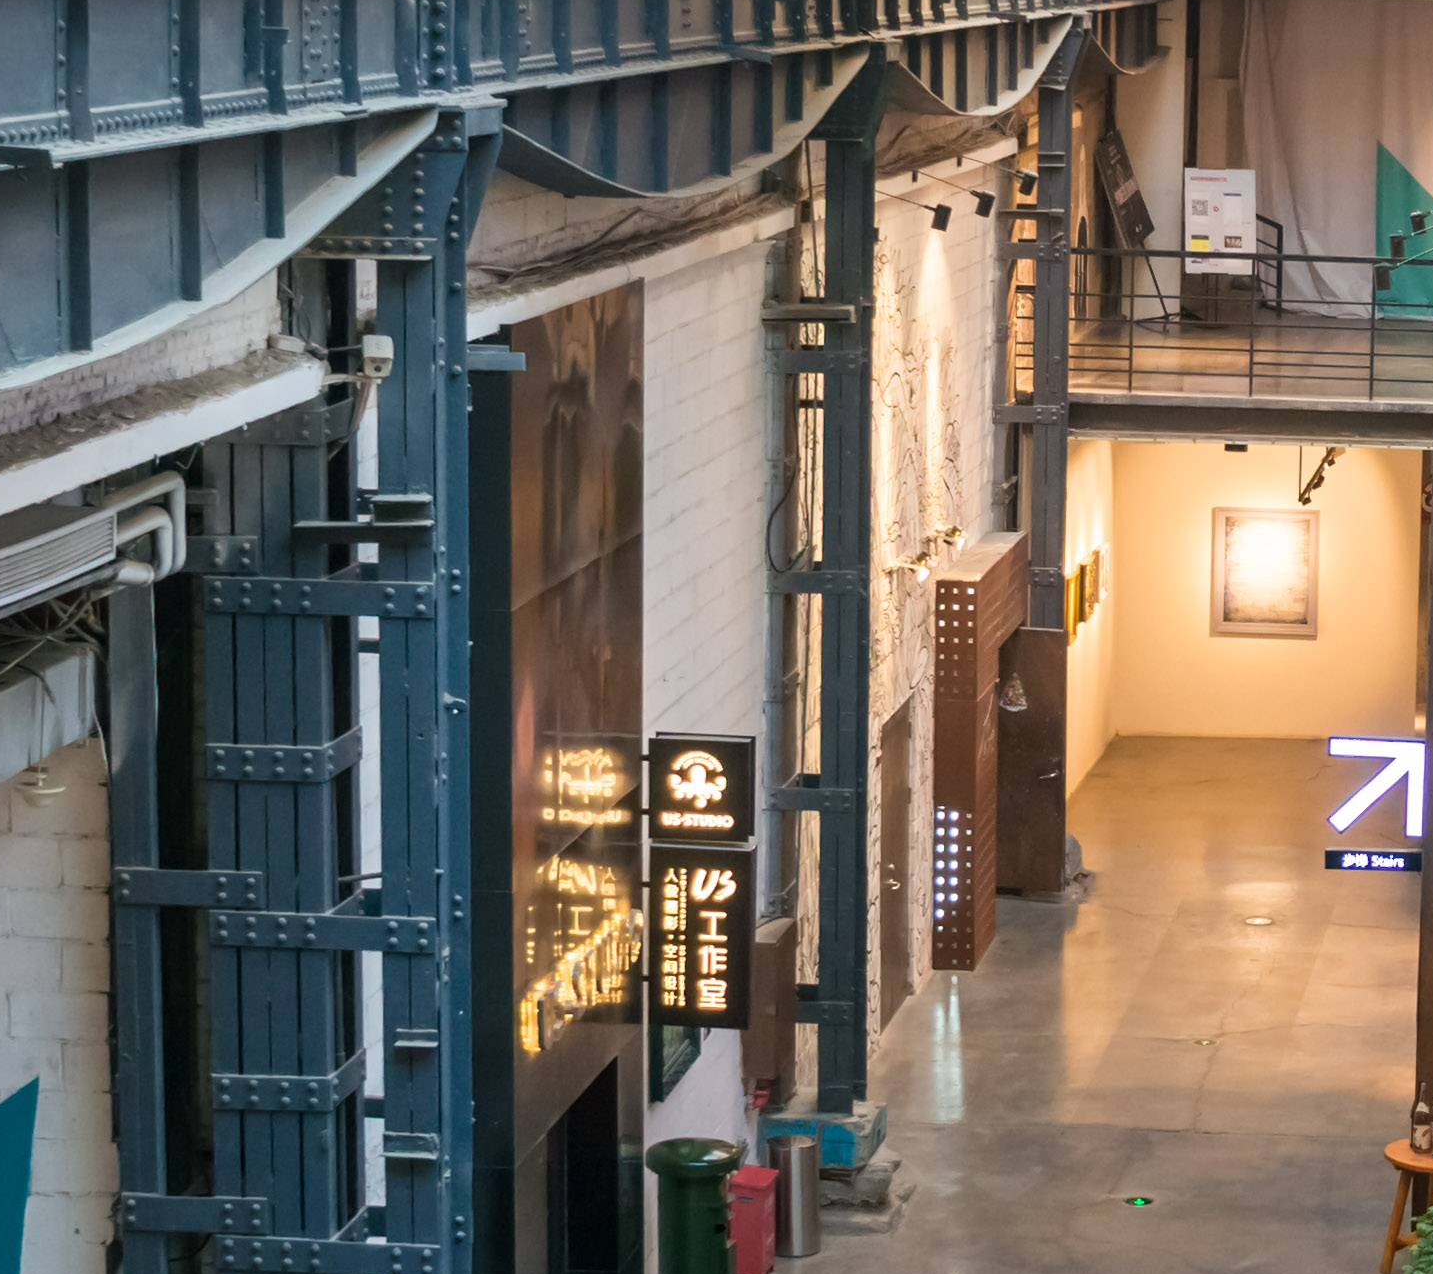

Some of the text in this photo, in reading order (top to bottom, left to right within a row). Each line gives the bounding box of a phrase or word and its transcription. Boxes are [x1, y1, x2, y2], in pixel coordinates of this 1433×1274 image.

[1371, 855, 1404, 868] Stairs
[691, 868, 737, 1010] US 工作室
